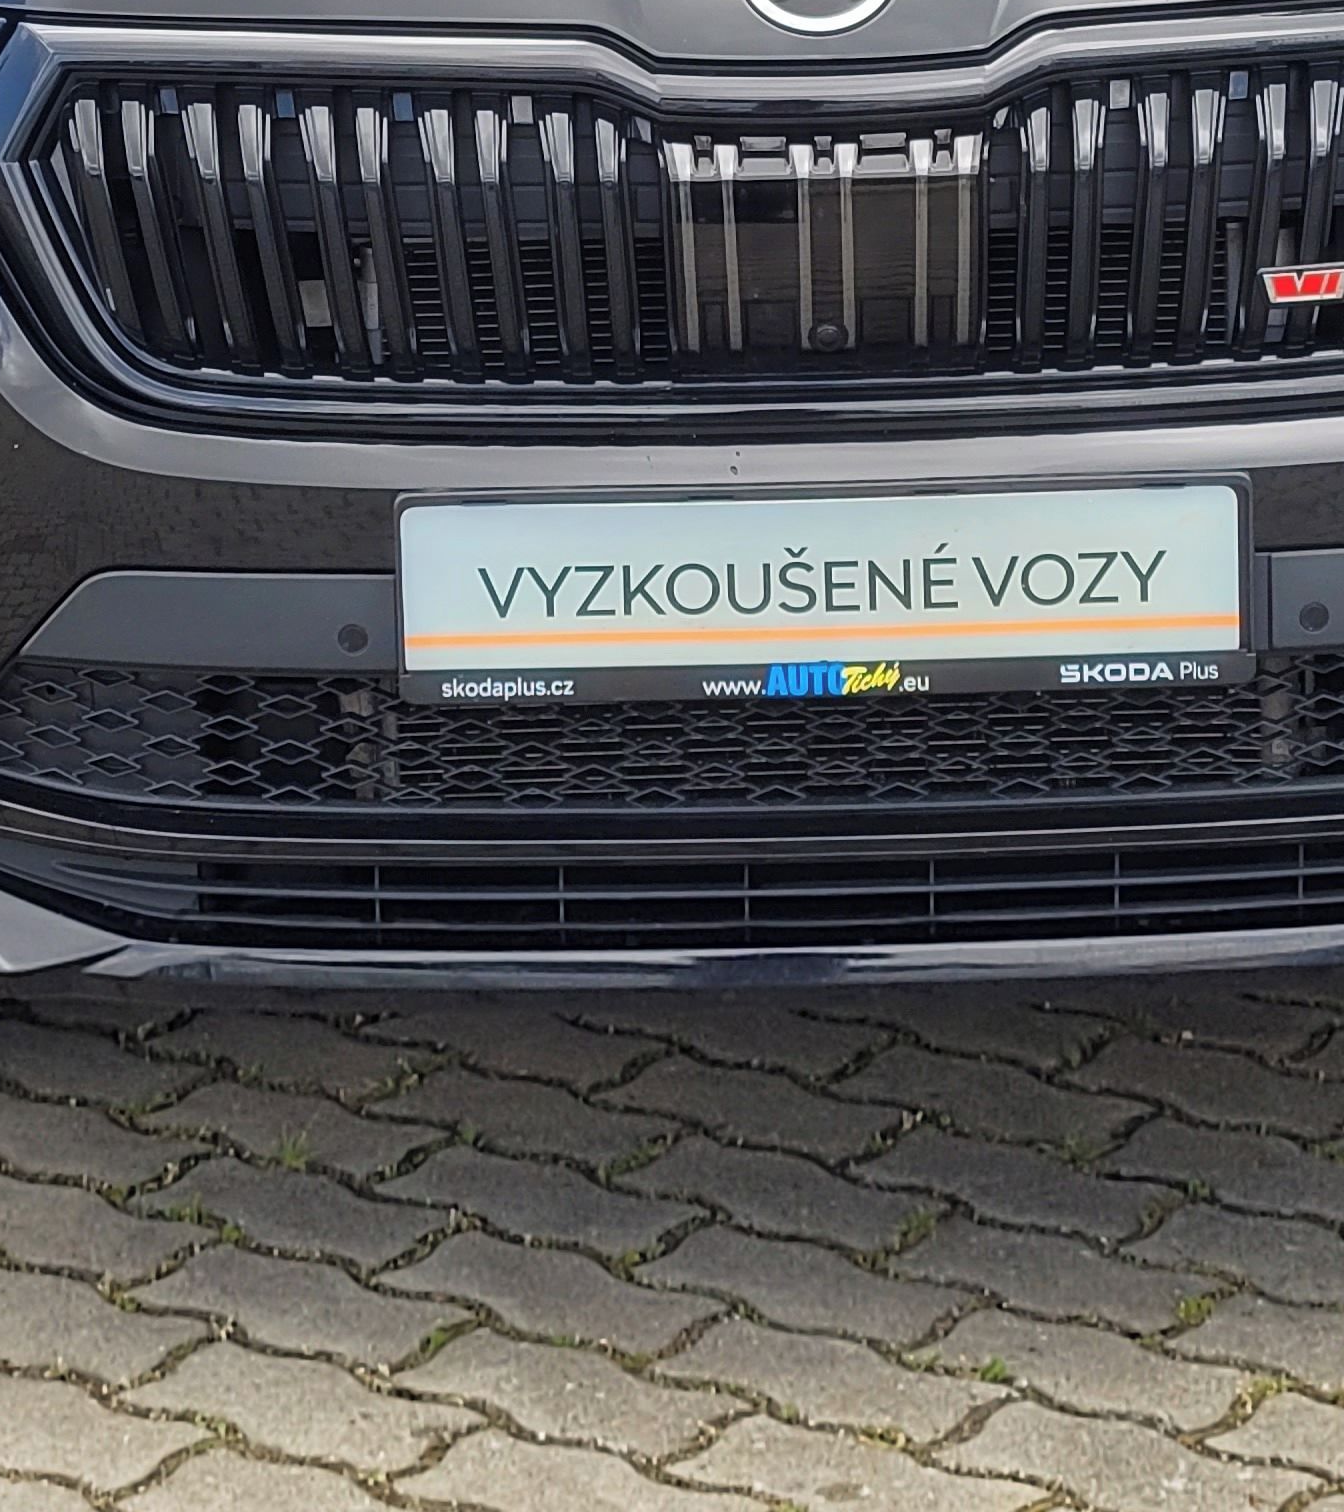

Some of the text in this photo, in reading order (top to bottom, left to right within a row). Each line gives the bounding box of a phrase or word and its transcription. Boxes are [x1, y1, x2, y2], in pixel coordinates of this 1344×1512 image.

[477, 542, 1167, 618] VYZKOUŠENÉ VOZY
[1179, 660, 1219, 680] Plus
[441, 676, 575, 702] skodaplus.cz
